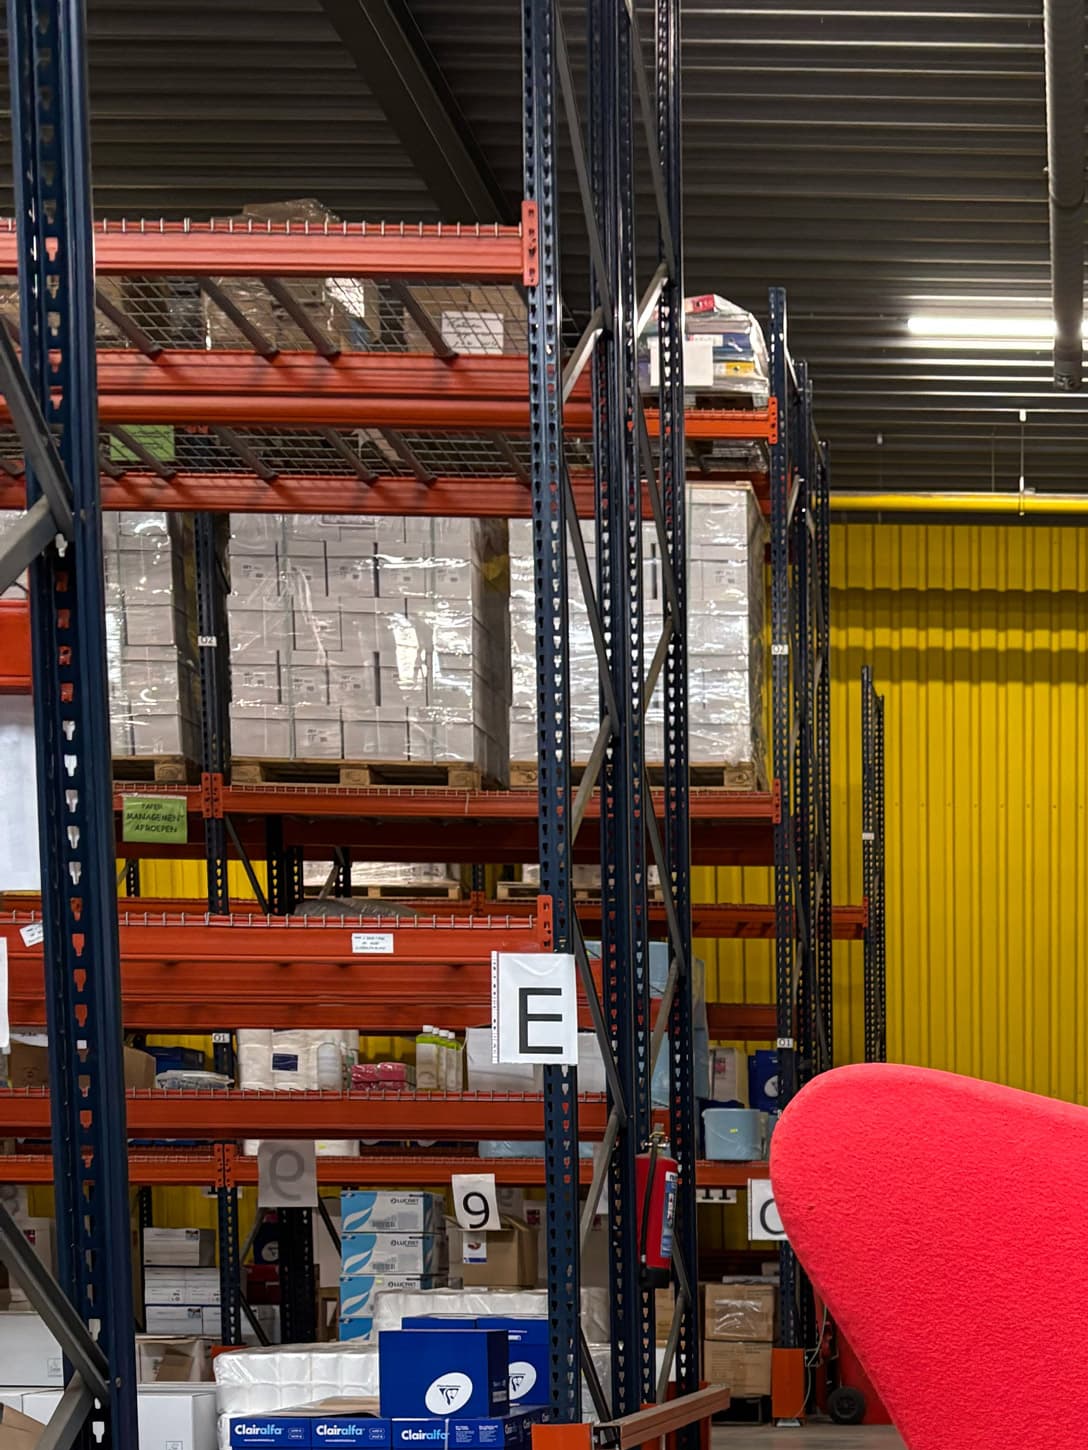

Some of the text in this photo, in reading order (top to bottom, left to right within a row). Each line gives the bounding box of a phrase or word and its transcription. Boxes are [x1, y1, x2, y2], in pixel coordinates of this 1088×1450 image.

[518, 987, 564, 1055] E
[462, 1191, 490, 1229] 9
[234, 1423, 284, 1436] Clairalfa
[315, 1424, 364, 1436] Clairalfa
[401, 1428, 448, 1441] Clairalfa
